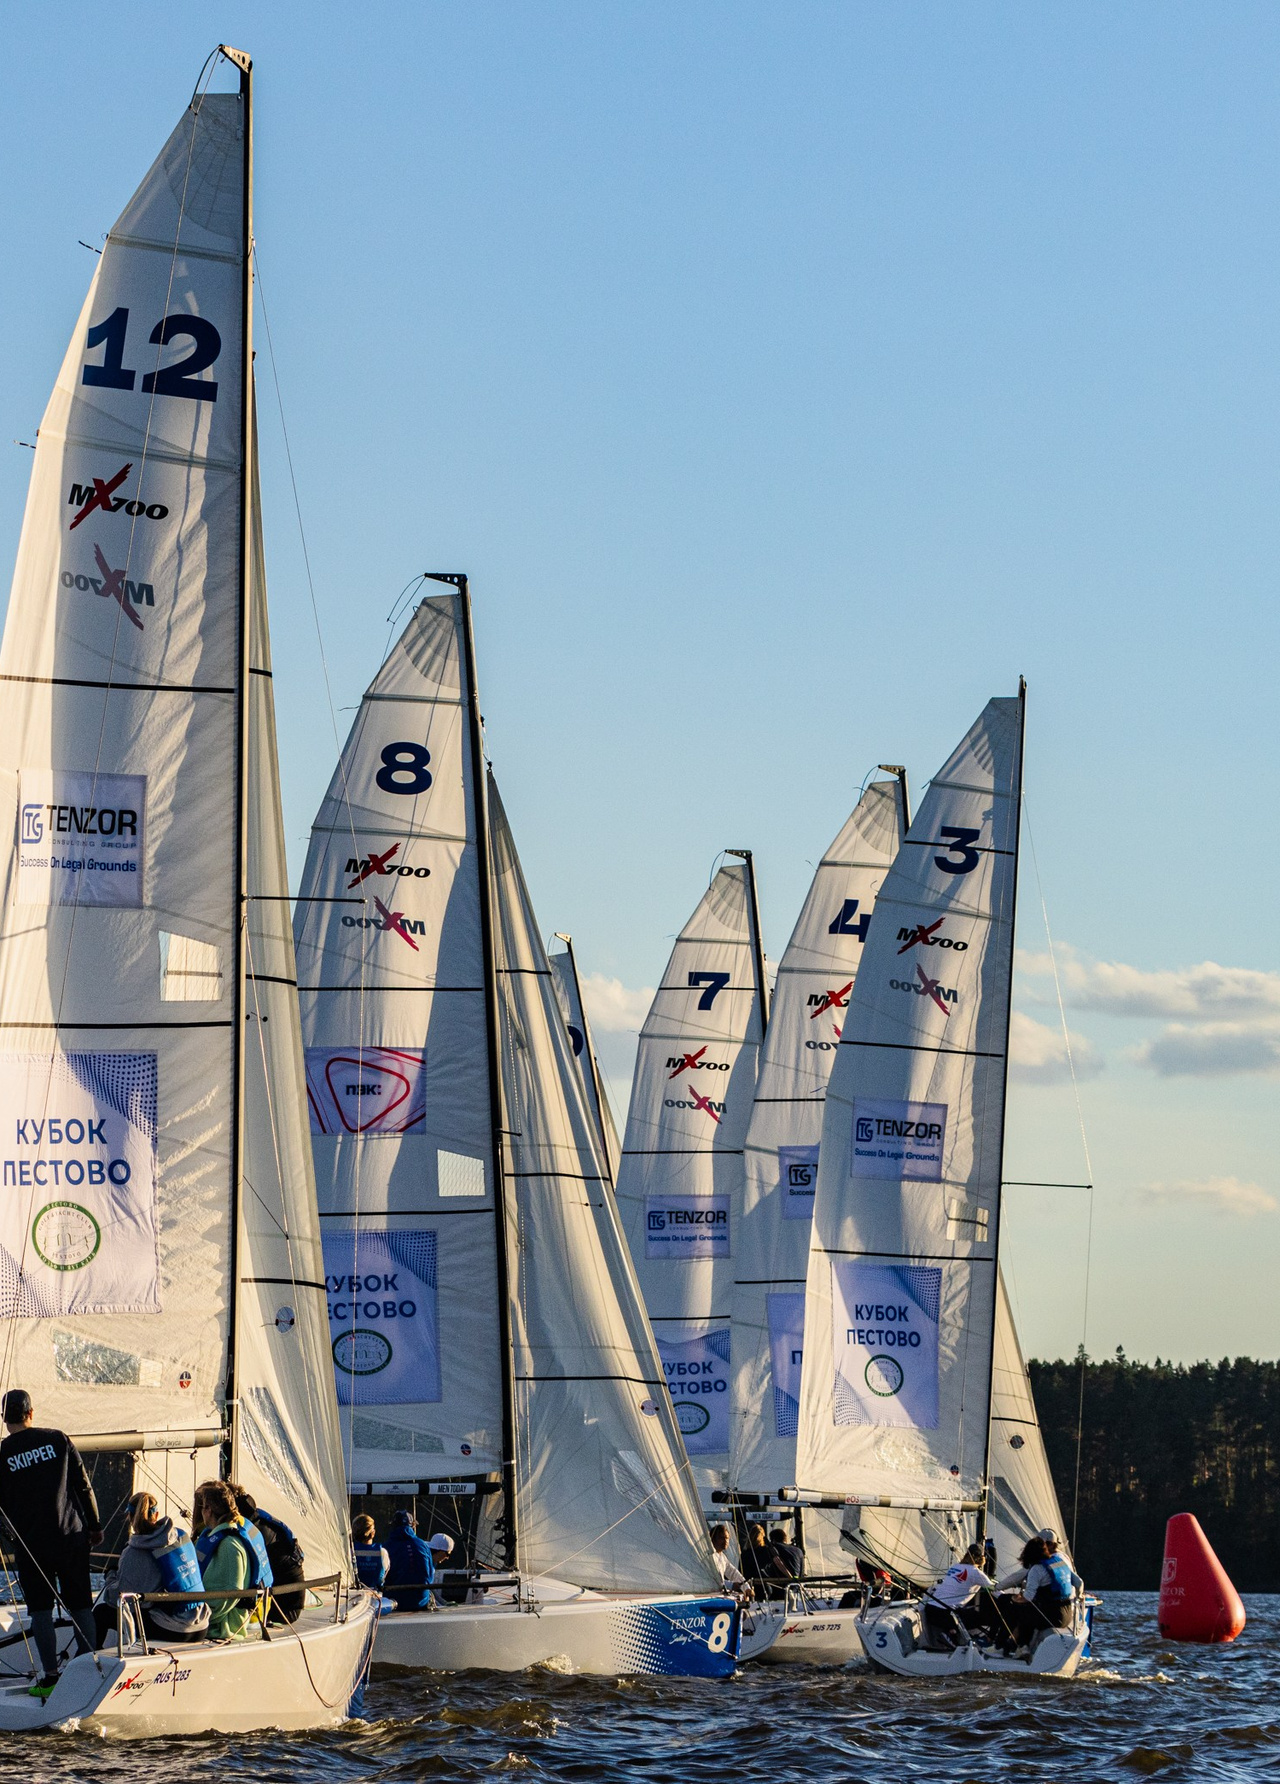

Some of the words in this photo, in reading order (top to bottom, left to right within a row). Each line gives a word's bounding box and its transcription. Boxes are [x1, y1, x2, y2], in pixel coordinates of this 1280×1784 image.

[82, 307, 221, 402] 12
[68, 463, 169, 530] MX700
[376, 742, 433, 795] 8
[47, 805, 137, 835] TENZOR
[21, 856, 48, 867] Success
[51, 857, 59, 868] On
[61, 857, 85, 872] Legal
[87, 859, 137, 872] Grounds
[934, 826, 980, 875] 3
[345, 842, 431, 890] MX700
[829, 899, 872, 943] 4
[897, 917, 968, 955] MX700
[688, 972, 730, 1011] 7
[807, 981, 855, 1019] MX7
[666, 1045, 730, 1079] MX700
[16, 1118, 108, 1145] КУБОК
[875, 1119, 942, 1140] TENZOR
[906, 1152, 939, 1162] Grounds
[3, 1159, 131, 1186] ПЕСТОВО
[667, 1210, 727, 1224] TENZOR
[327, 1300, 417, 1320] СТОВО
[855, 1304, 910, 1322] КУБОК
[847, 1329, 921, 1348] ПЕСТОВО
[668, 1379, 727, 1395] СТОВО
[7, 1444, 57, 1472] SKIPPER
[437, 1484, 450, 1493] MEN
[451, 1484, 467, 1493] TODAY
[671, 1616, 706, 1630] TENZOR
[708, 1613, 730, 1653] 8
[875, 1632, 887, 1648] 3
[153, 1672, 172, 1684] RUS
